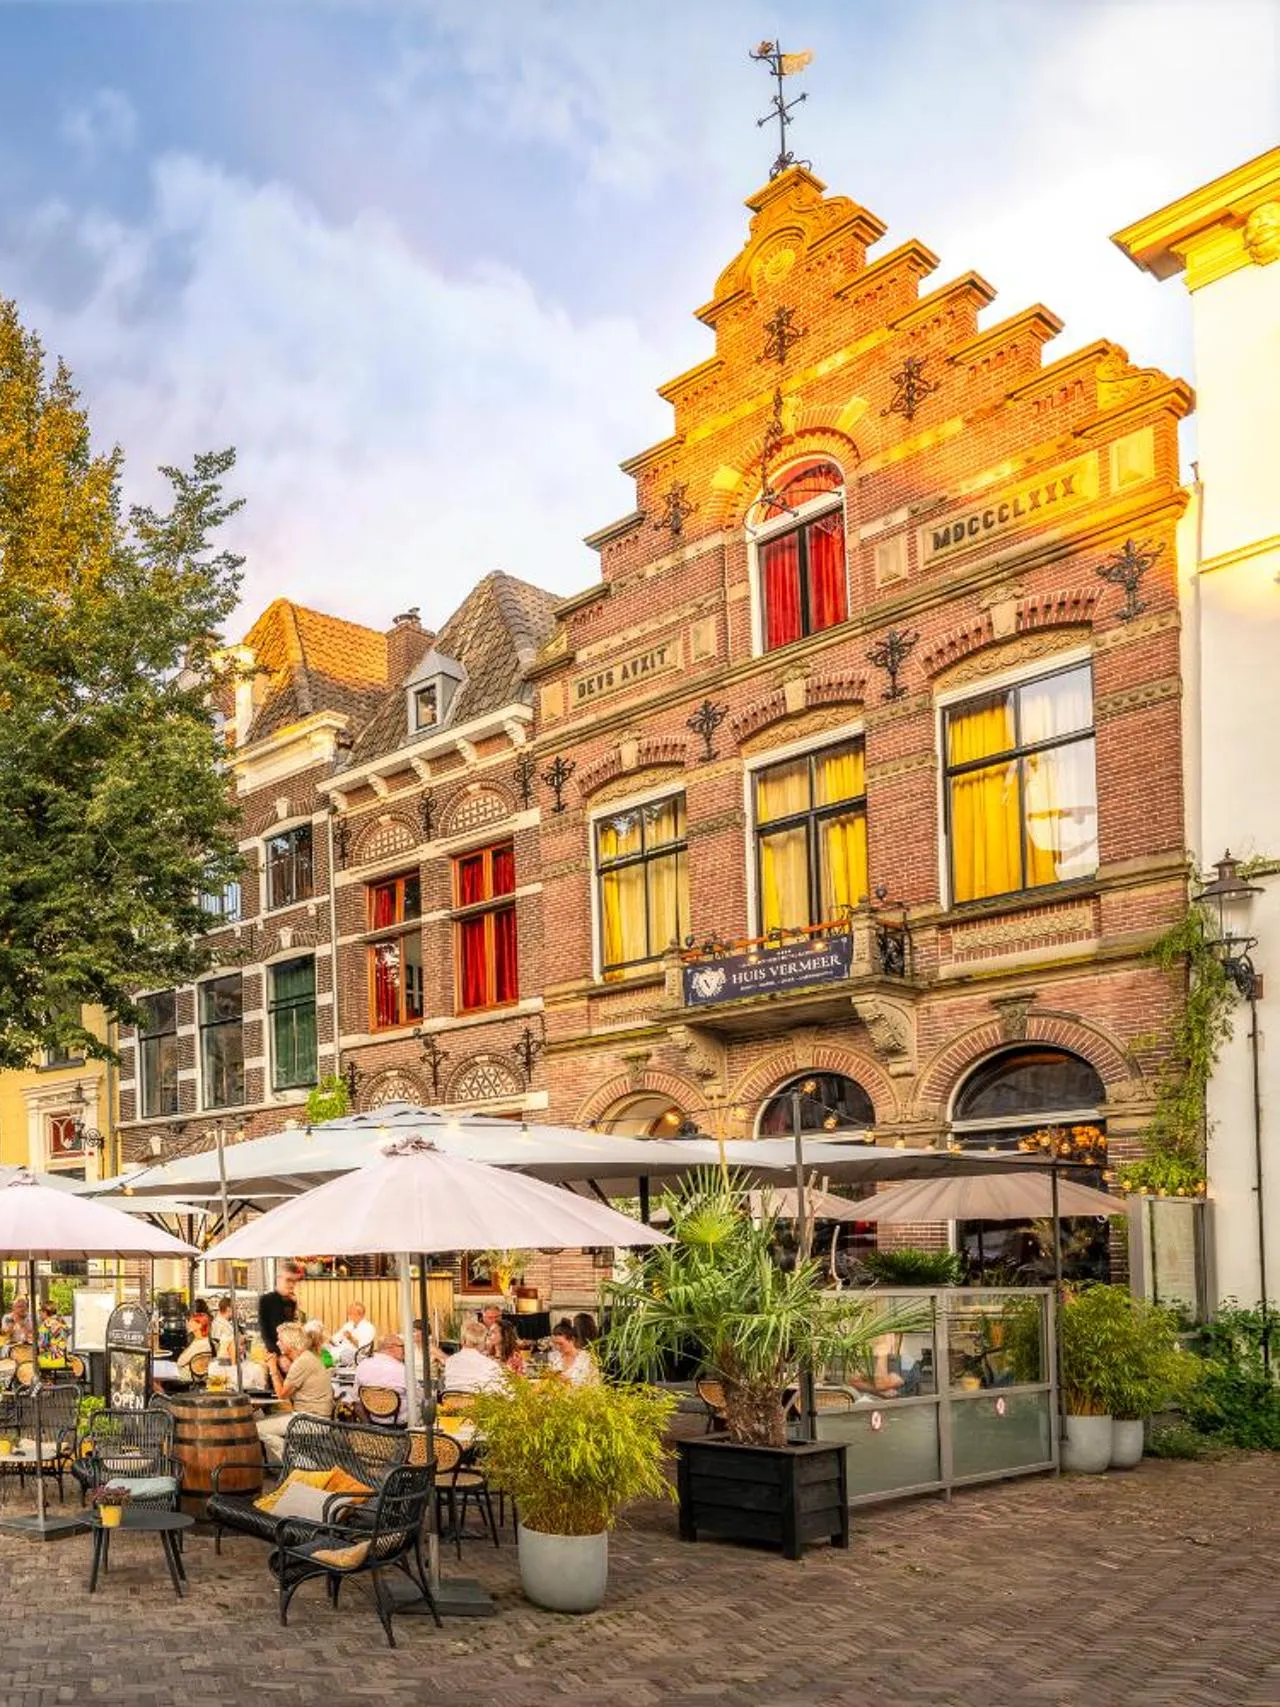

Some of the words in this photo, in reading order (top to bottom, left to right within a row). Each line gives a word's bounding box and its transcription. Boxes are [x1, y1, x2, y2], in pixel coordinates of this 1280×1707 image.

[932, 474, 1075, 550] MDCCCLXXX
[578, 670, 614, 699] DEVS
[732, 967, 766, 985] HUIS
[769, 954, 842, 977] VERMEER
[112, 1391, 145, 1410] OPEN
